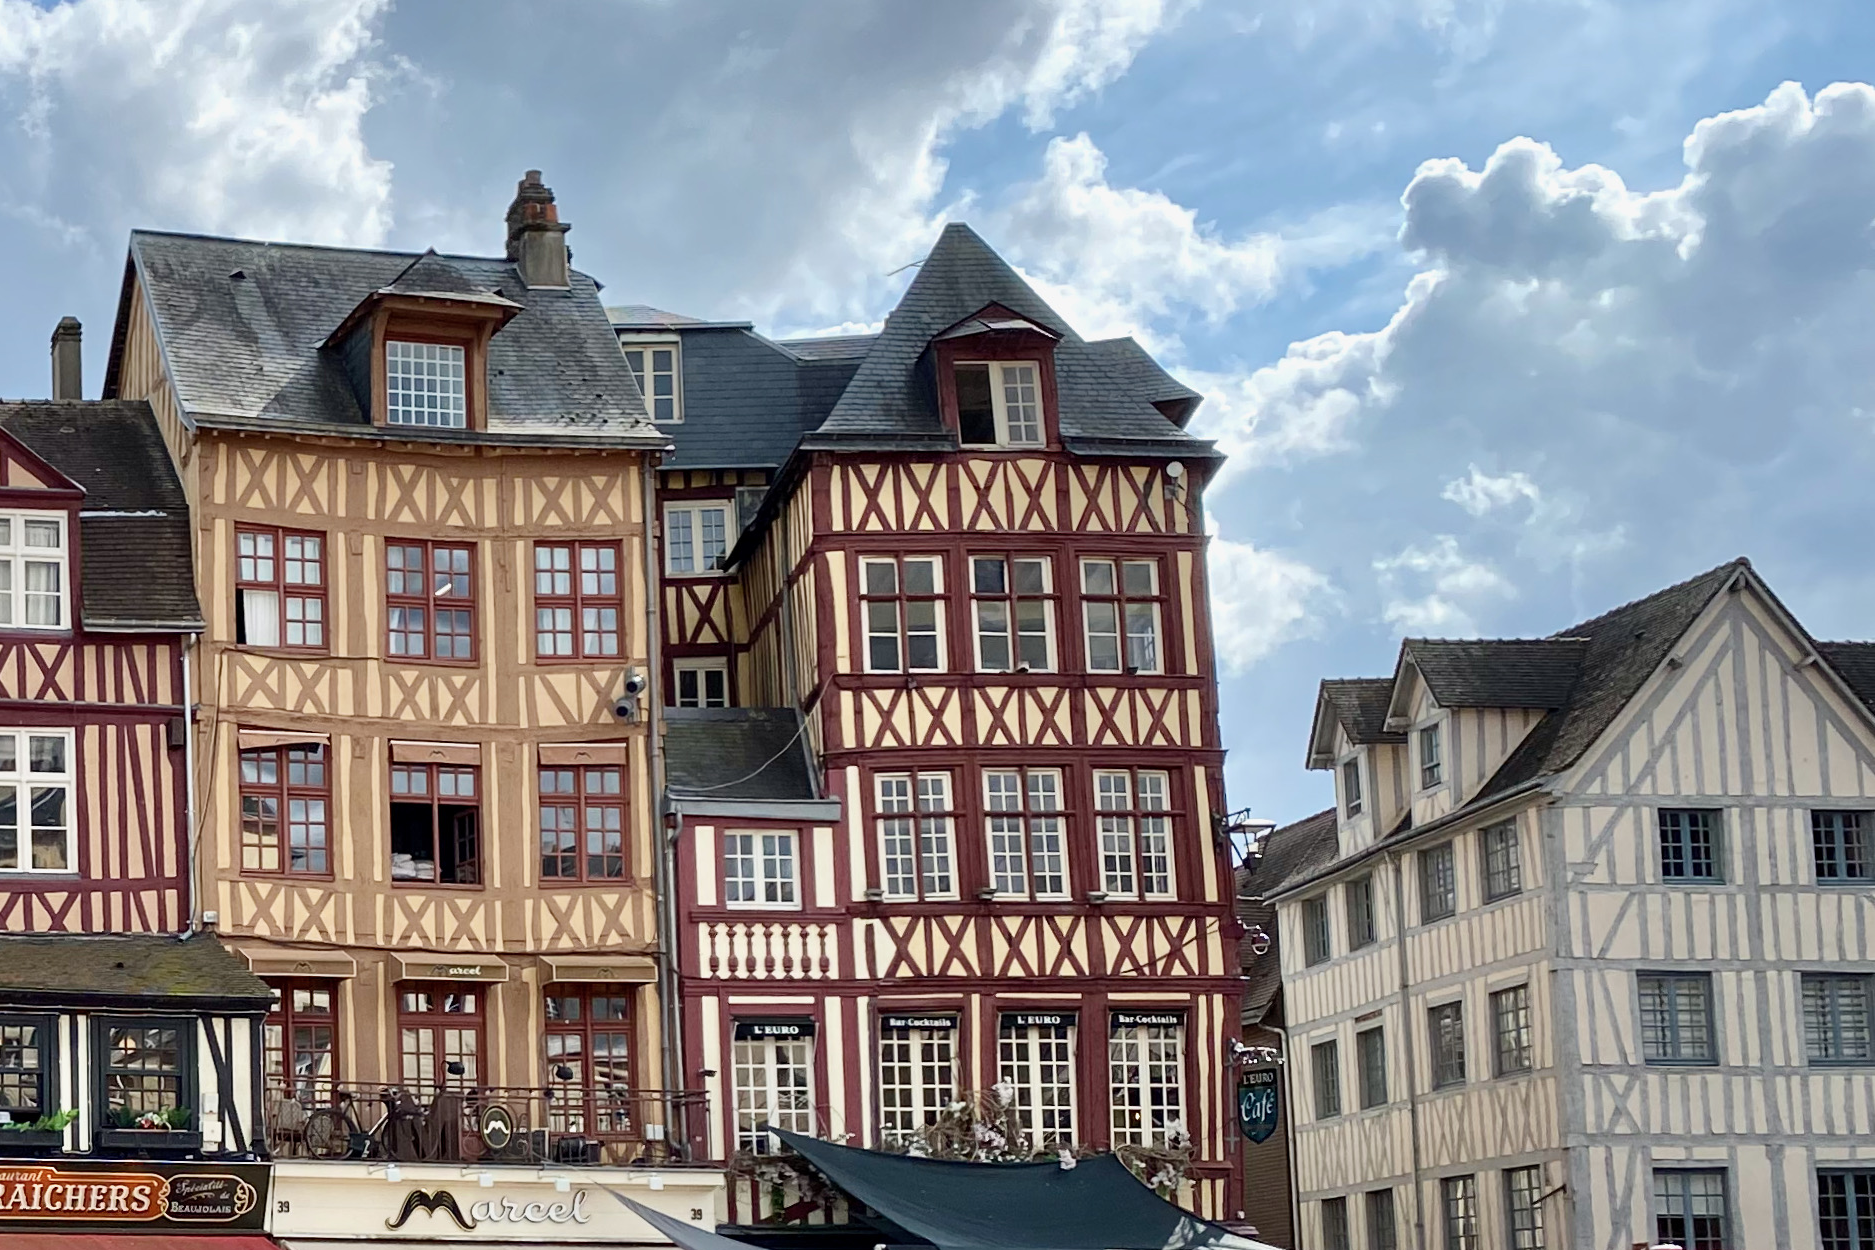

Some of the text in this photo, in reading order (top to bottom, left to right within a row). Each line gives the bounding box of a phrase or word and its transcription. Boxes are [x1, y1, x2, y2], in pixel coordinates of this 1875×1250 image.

[1017, 1015, 1061, 1025] L'EURO
[753, 1025, 799, 1035] L'EURO
[1242, 1072, 1274, 1085] L'EURO
[1240, 1088, 1275, 1122] Café
[170, 1201, 232, 1214] BEAUJOLAIS
[277, 1200, 290, 1213] 39
[384, 1188, 592, 1232] Marcel
[690, 1208, 703, 1220] 39
